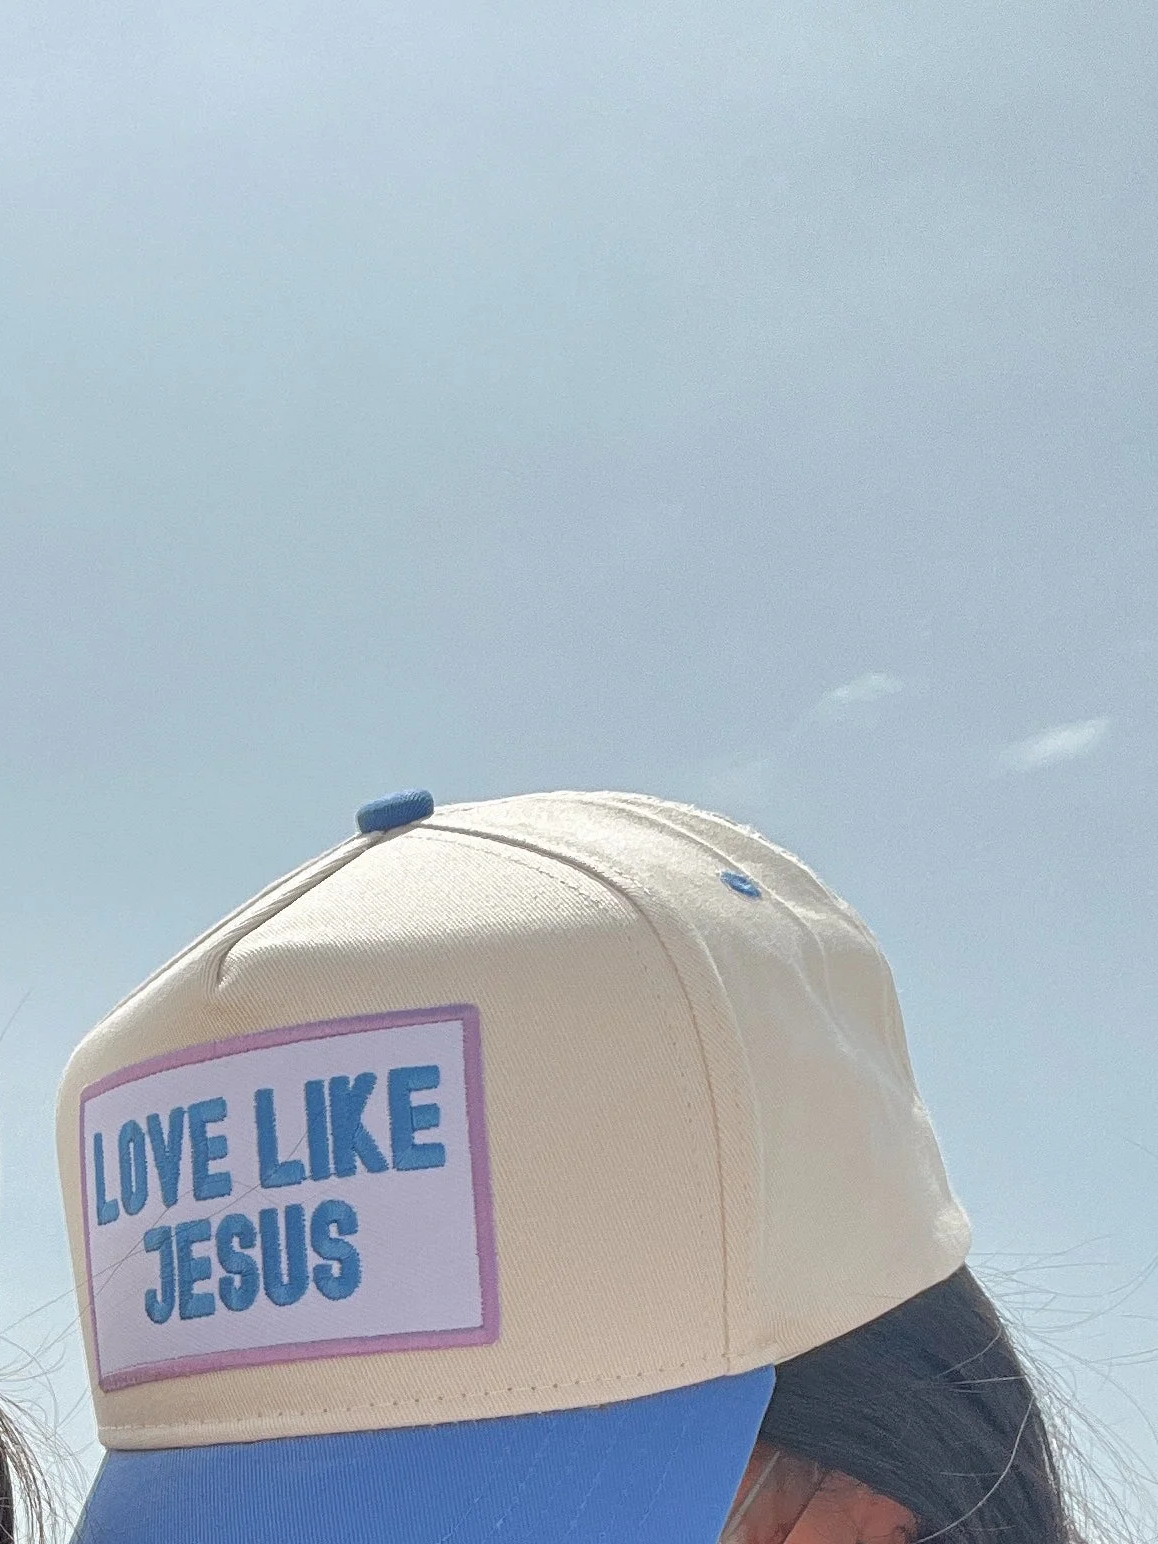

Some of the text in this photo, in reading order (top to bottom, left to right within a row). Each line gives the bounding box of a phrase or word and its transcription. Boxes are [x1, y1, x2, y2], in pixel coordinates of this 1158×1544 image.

[94, 1064, 445, 1226] LOVE LIKE
[143, 1199, 363, 1325] JESUS
